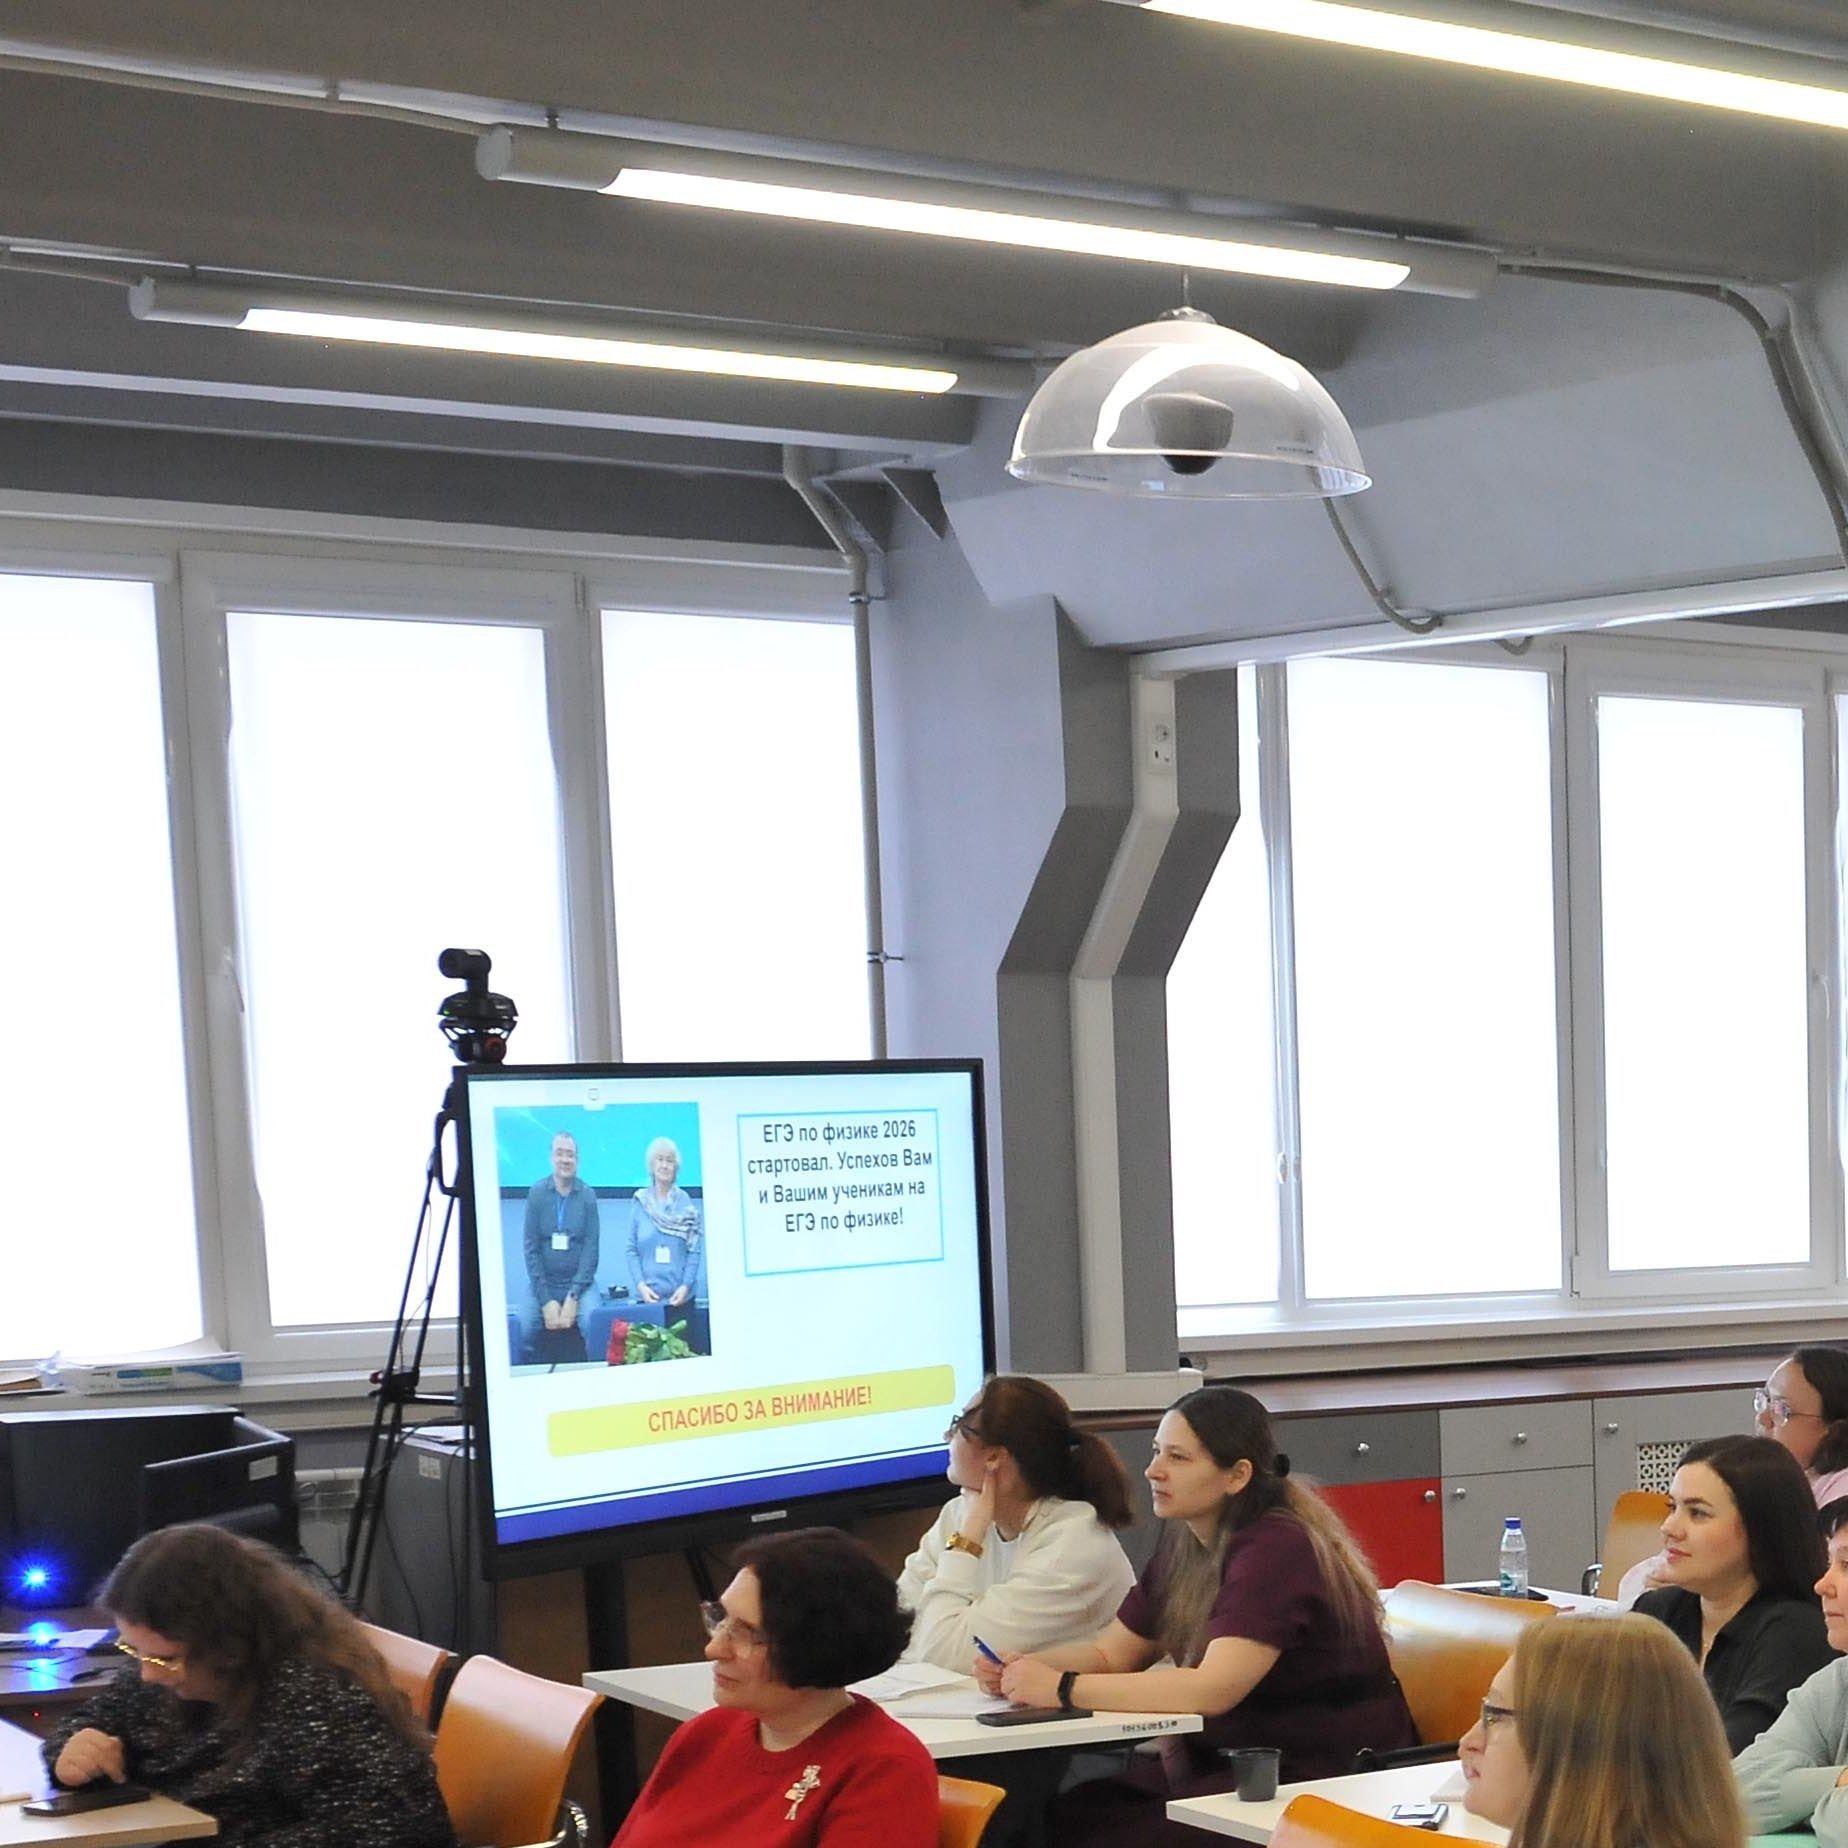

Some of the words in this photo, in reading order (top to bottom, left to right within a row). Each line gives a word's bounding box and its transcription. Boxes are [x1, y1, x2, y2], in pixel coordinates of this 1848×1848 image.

[763, 1123, 793, 1143] ЕГЭ
[799, 1127, 818, 1141] по
[823, 1122, 878, 1144] физике
[883, 1120, 916, 1138] 2026
[748, 1157, 833, 1178] стартовал.
[837, 1152, 898, 1170] Успехов
[903, 1149, 932, 1166] Вам
[759, 1190, 768, 1204] и
[773, 1185, 828, 1203] Вашим
[832, 1182, 904, 1204] ученикам
[908, 1181, 925, 1195] на
[785, 1213, 815, 1232] ЕГЭ
[821, 1216, 839, 1230] по
[844, 1207, 903, 1232] физике!
[649, 1402, 738, 1432] СПАСИБО
[744, 1400, 767, 1420] ЗА
[771, 1386, 872, 1416] ВНИМАНИЕ!
